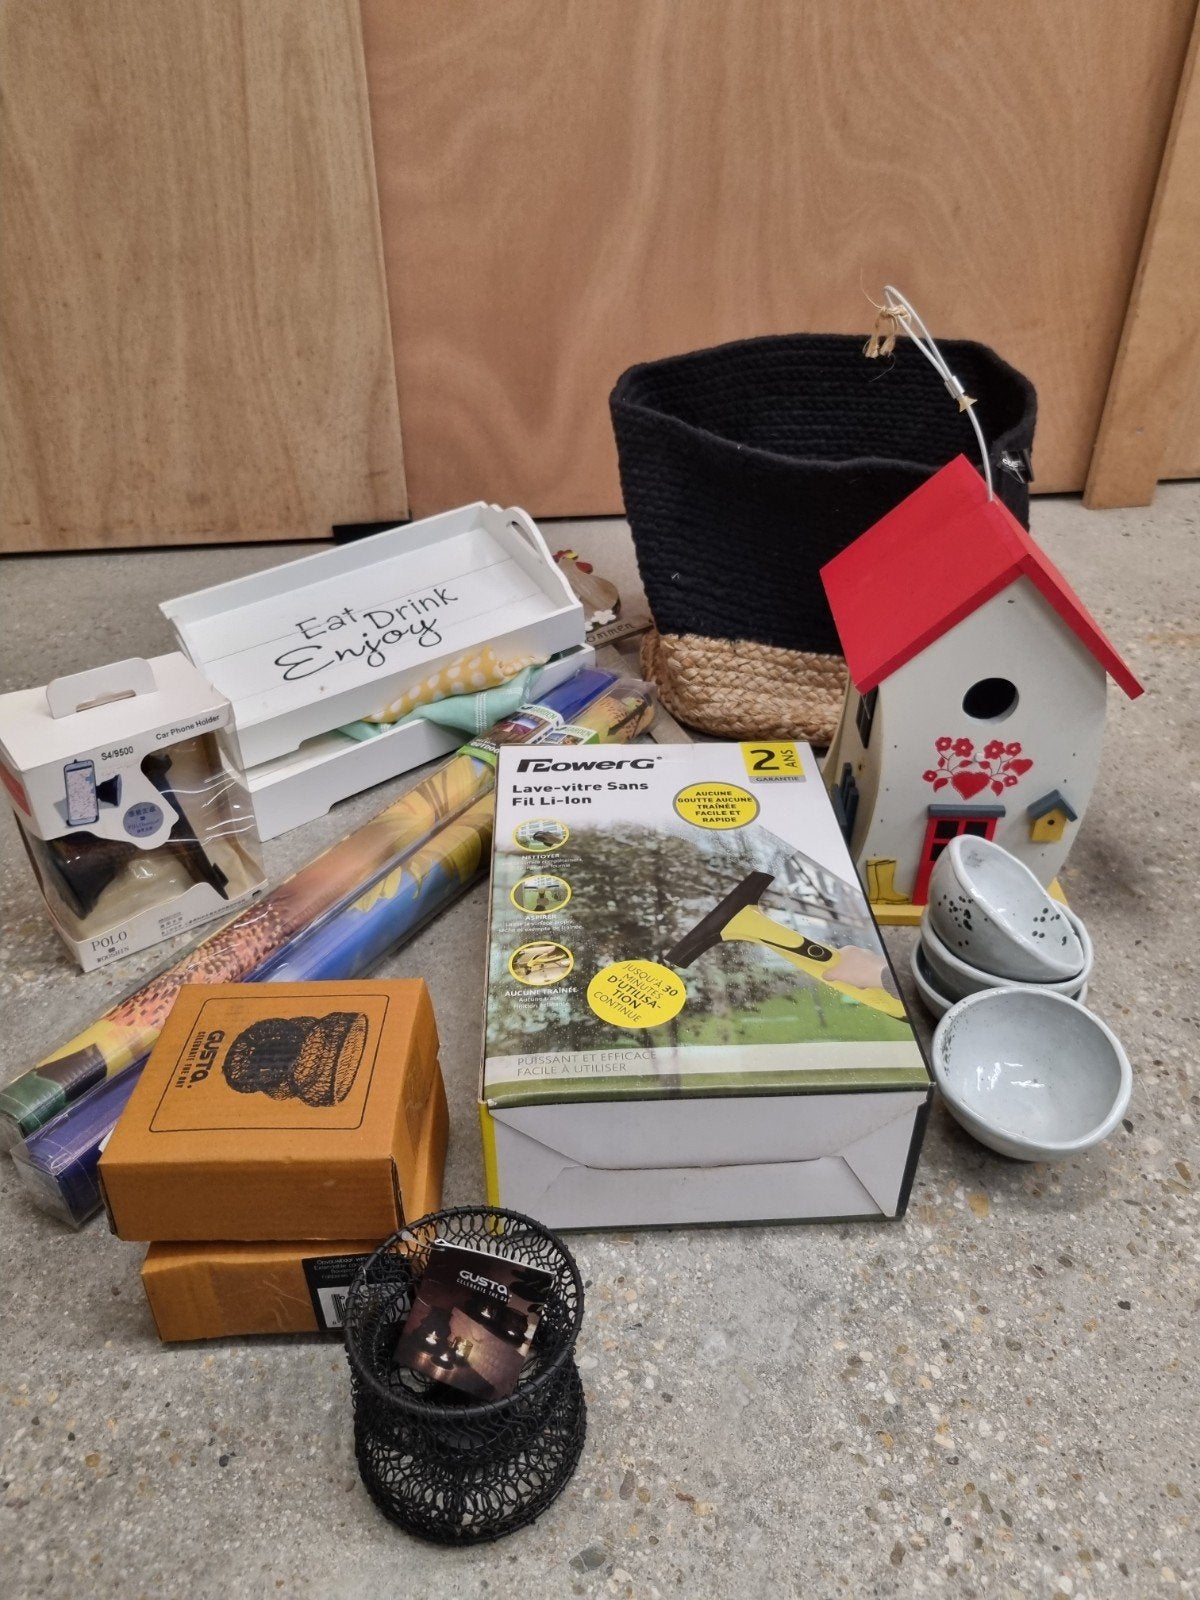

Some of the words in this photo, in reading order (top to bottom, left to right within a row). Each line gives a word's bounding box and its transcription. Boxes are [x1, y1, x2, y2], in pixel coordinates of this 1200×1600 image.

[295, 607, 358, 640] Eat
[363, 588, 459, 630] Drink
[586, 623, 636, 643] ommen
[274, 618, 443, 681] Enjoy
[155, 731, 170, 741] Car
[170, 723, 195, 736] Phone
[195, 714, 221, 728] Holder
[100, 745, 135, 761] S4/9500
[749, 749, 780, 771] 2
[780, 749, 799, 769] ANS
[512, 783, 603, 794] Lave-vitre
[607, 781, 650, 791] Sans
[512, 797, 535, 807] Fil
[540, 795, 593, 806] Li-Ion
[521, 853, 560, 861] NETTOYER
[91, 930, 128, 952] POLO
[622, 962, 663, 988] JUSQU'À
[662, 985, 679, 998] 30
[622, 973, 663, 1000] MINUTES
[504, 989, 540, 997] AUCUNE
[607, 975, 661, 1009] D'UTILISA-
[613, 989, 642, 1010] TION
[593, 991, 642, 1023] CONTINUE
[517, 1054, 577, 1066] PUISSANT
[583, 1053, 599, 1063] ET
[601, 1050, 656, 1062] EFFICACE
[517, 1066, 558, 1077] FACILE
[561, 1064, 570, 1074] À
[574, 1063, 627, 1074] UTILISER
[456, 1278, 487, 1294] CELEBRATE
[488, 1290, 498, 1299] THE
